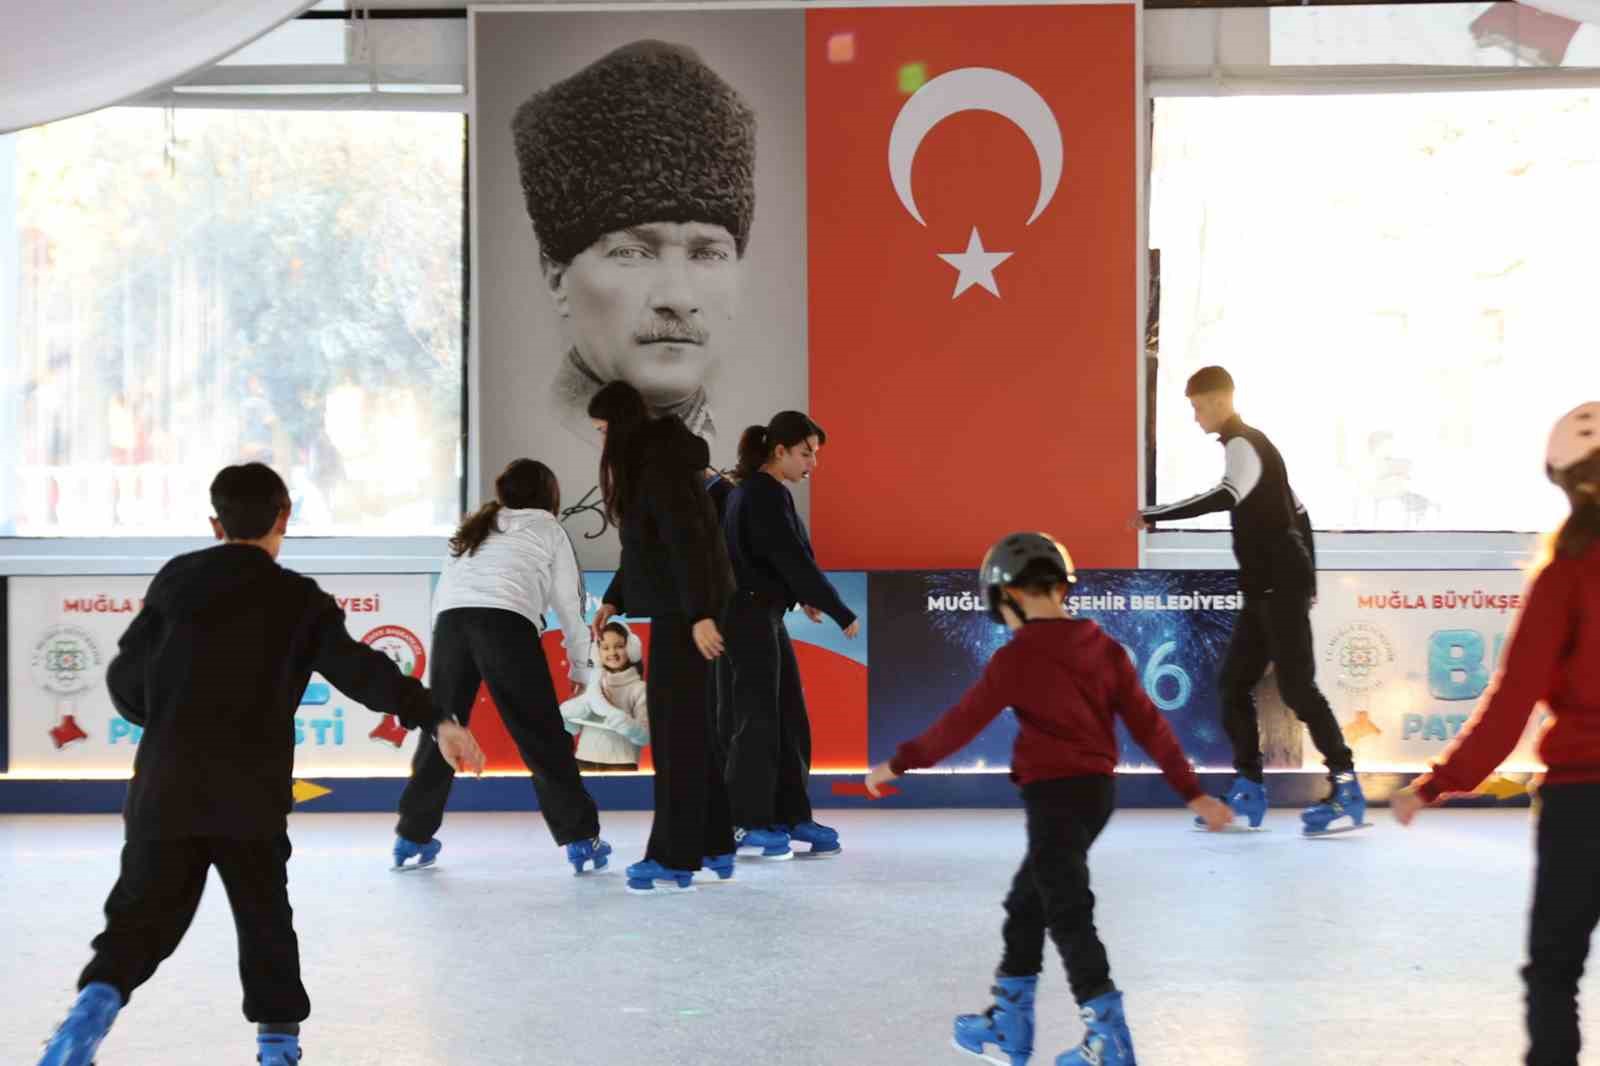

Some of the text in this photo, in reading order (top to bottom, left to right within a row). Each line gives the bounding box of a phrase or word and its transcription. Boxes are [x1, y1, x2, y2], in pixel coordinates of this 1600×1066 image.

[64, 594, 133, 613] MUĞLA
[927, 591, 1243, 615] MUĞL ŞEHİR BELEDİYESİ
[1358, 590, 1522, 614] MUĞLA BÜYÜKŞE
